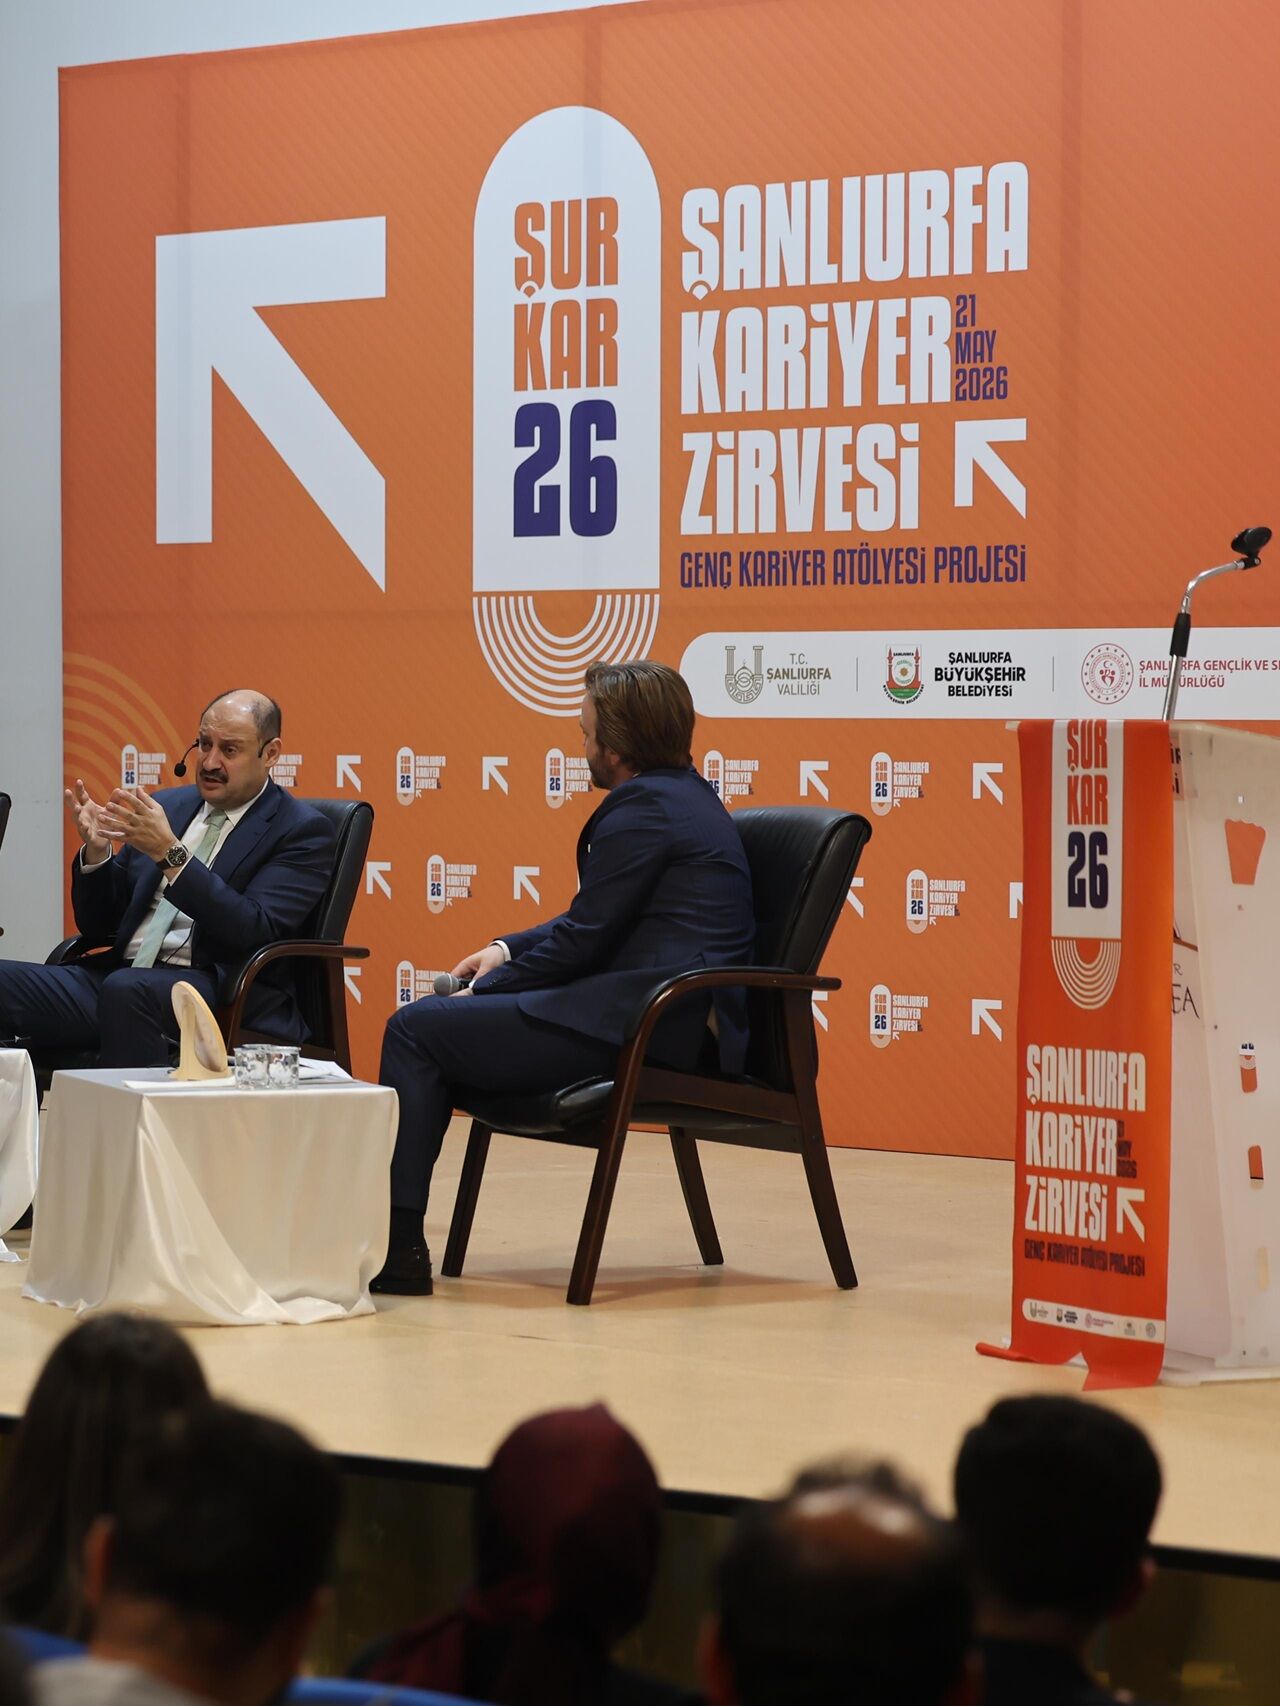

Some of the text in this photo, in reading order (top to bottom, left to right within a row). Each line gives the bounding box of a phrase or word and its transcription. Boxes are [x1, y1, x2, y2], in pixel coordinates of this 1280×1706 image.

[514, 196, 618, 298] ŞUR
[681, 161, 1028, 300] ŞANLIURFA
[956, 294, 977, 328] 21
[514, 298, 618, 392] KAR
[680, 295, 952, 415] KARİYER
[955, 330, 996, 364] MAY
[955, 365, 1008, 402] 2026
[513, 399, 618, 537] 26
[680, 423, 919, 535] ZİRVESİ
[680, 542, 1026, 589] GENÇ KARİYER ATÖLYESİ PROJESİ
[766, 667, 831, 682] ŞANLIURFA
[789, 653, 808, 665] T.C.
[934, 666, 1026, 684] BÜYÜKŞEHİR
[948, 651, 1012, 665] ŞANLIURFA
[1139, 660, 1202, 673] ŞANLIRFA
[1203, 657, 1252, 673] GENÇLİK
[1254, 659, 1269, 671] VE
[777, 680, 820, 696] VALİLİĞİ
[947, 684, 1012, 697] BELEDİYESİ
[1139, 674, 1225, 688] İL MÜÜRLÜĞÜ
[400, 775, 411, 789] 26
[549, 777, 561, 791] 26
[875, 782, 888, 797] 26
[1067, 774, 1109, 825] KAR
[1067, 831, 1109, 909] 26
[430, 883, 441, 896] 26
[911, 900, 923, 915] 26
[874, 1015, 887, 1030] 26
[1026, 1044, 1146, 1112] ŞANLIURFA
[1025, 1109, 1117, 1177] KARİYER
[1024, 1174, 1108, 1242] ZİRVESİ
